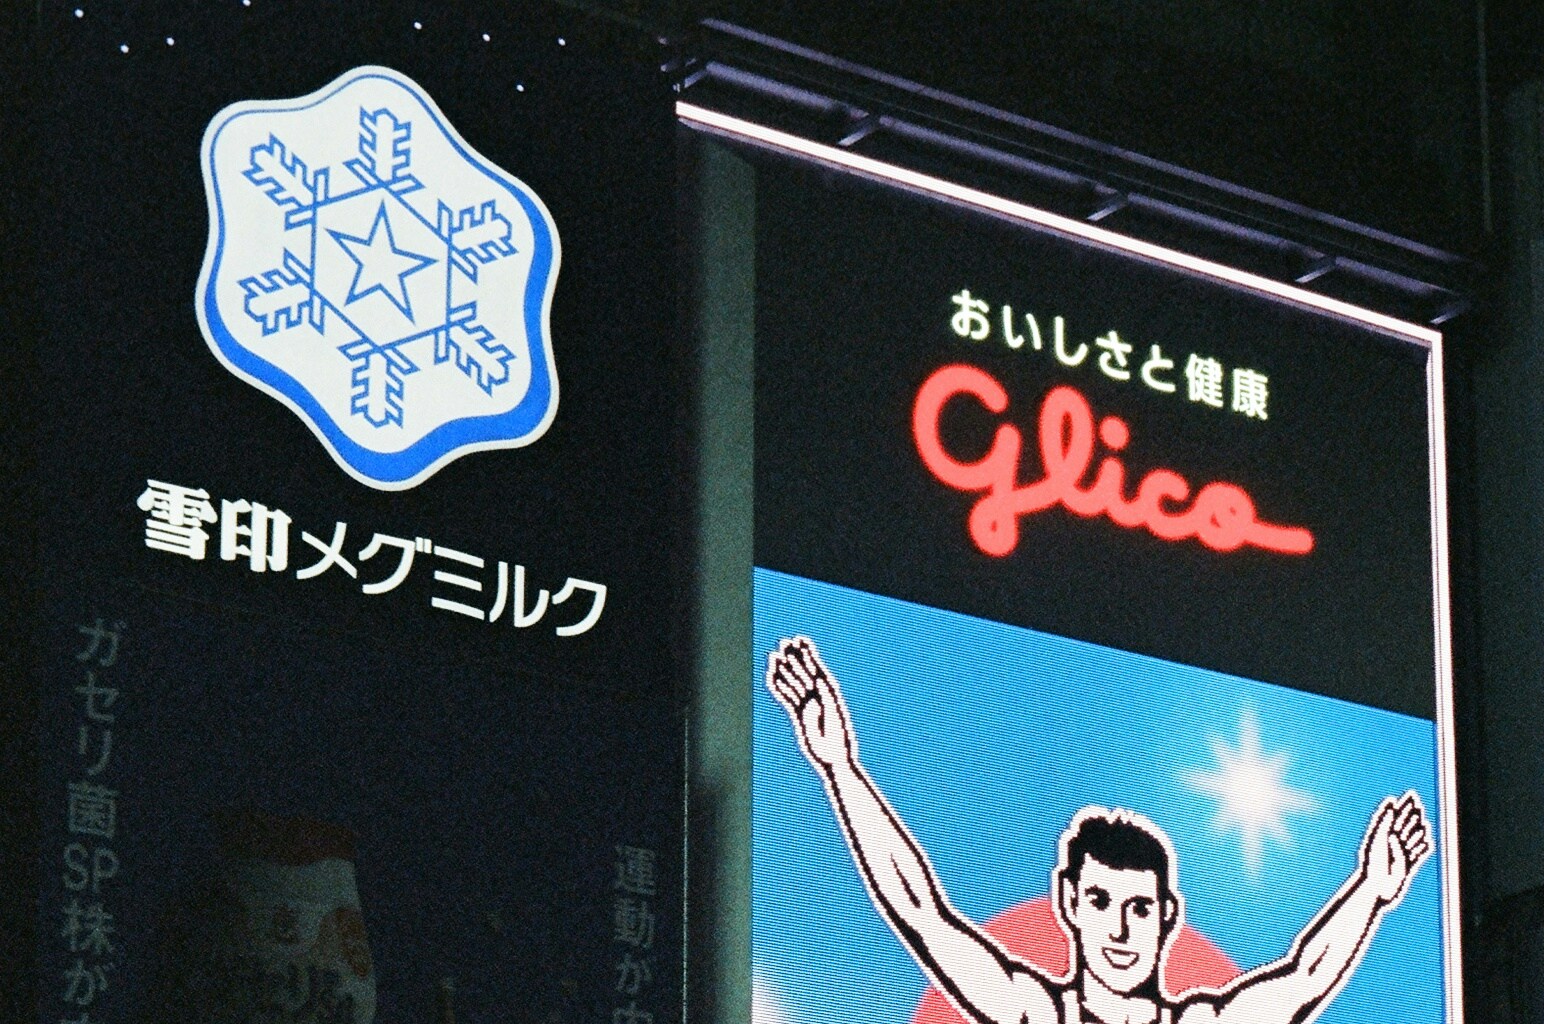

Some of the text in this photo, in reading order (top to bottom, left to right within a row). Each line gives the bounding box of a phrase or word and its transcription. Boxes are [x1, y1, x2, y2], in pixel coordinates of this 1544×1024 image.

[950, 288, 1270, 421] おいしさと健康
[912, 362, 1316, 557] Glico
[136, 478, 607, 637] 雪印メグミルク
